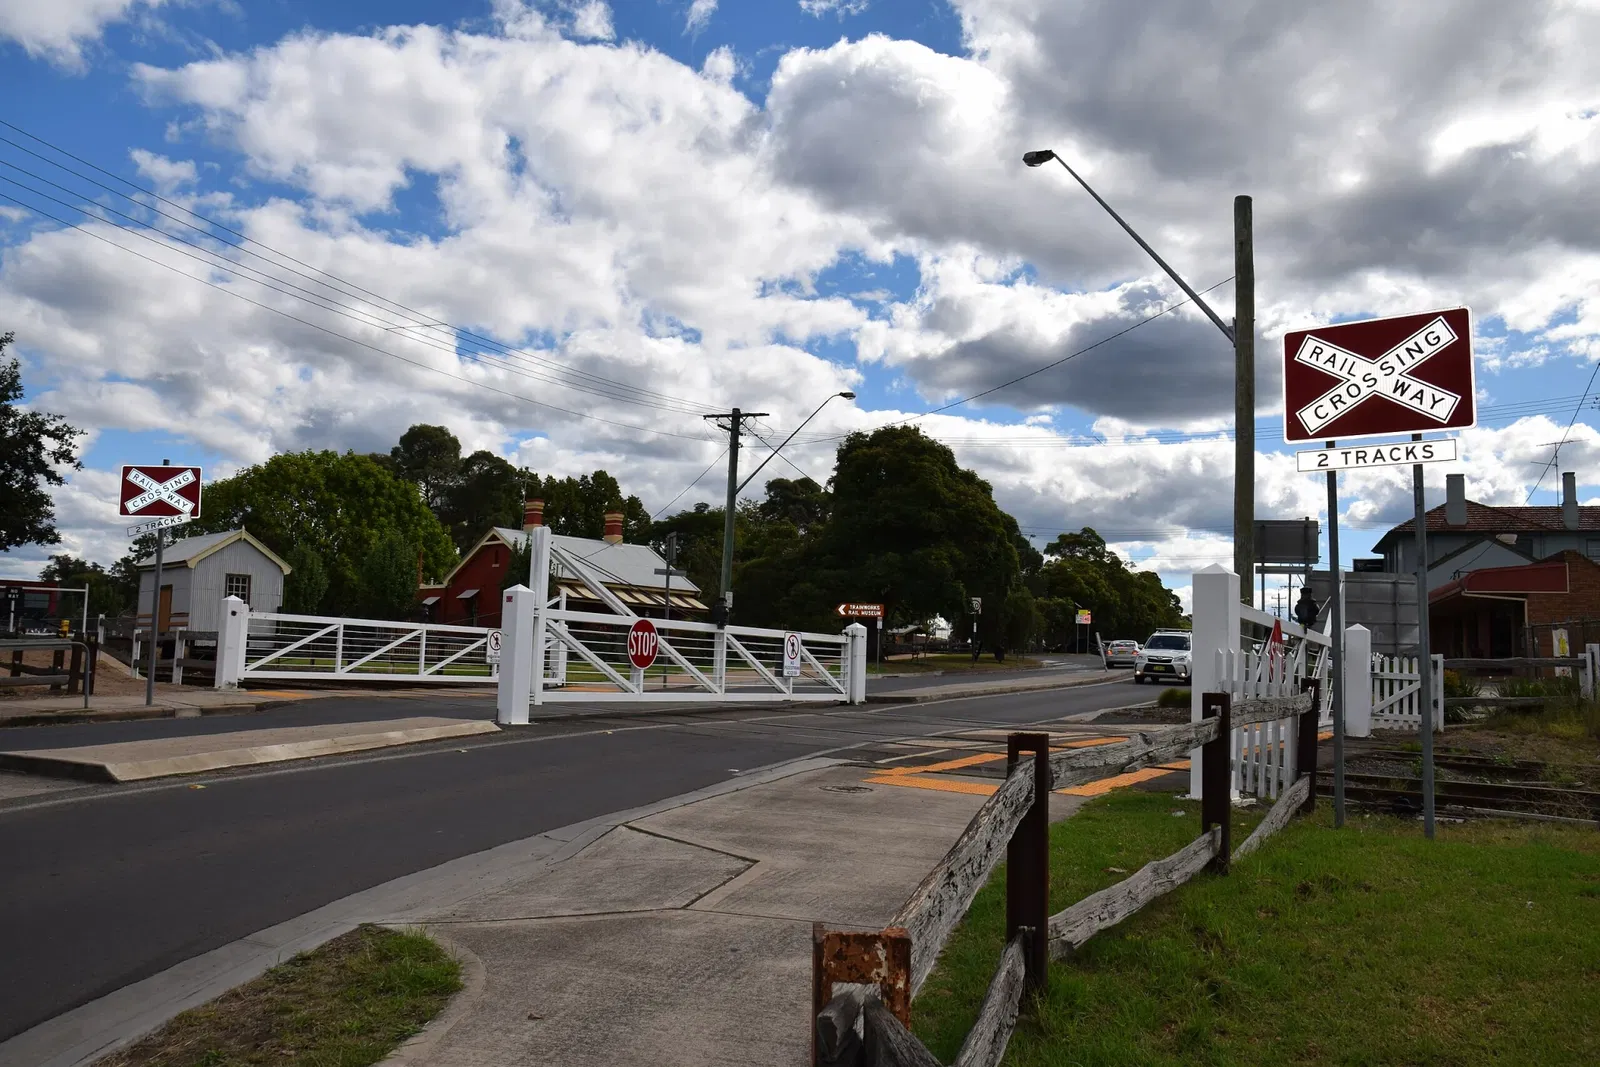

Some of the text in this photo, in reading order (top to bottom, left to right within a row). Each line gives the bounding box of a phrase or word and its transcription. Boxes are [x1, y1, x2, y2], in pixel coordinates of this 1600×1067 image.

[1309, 345, 1357, 377] RAIL
[1314, 330, 1441, 420] CROSSING
[1392, 379, 1446, 410] WAY
[1317, 444, 1434, 467] 2 TRACKS
[132, 473, 153, 491] RAIL
[132, 474, 190, 508] CROSSING
[167, 493, 189, 508] WAY
[145, 515, 183, 530] TRACKS
[630, 630, 657, 657] STOP
